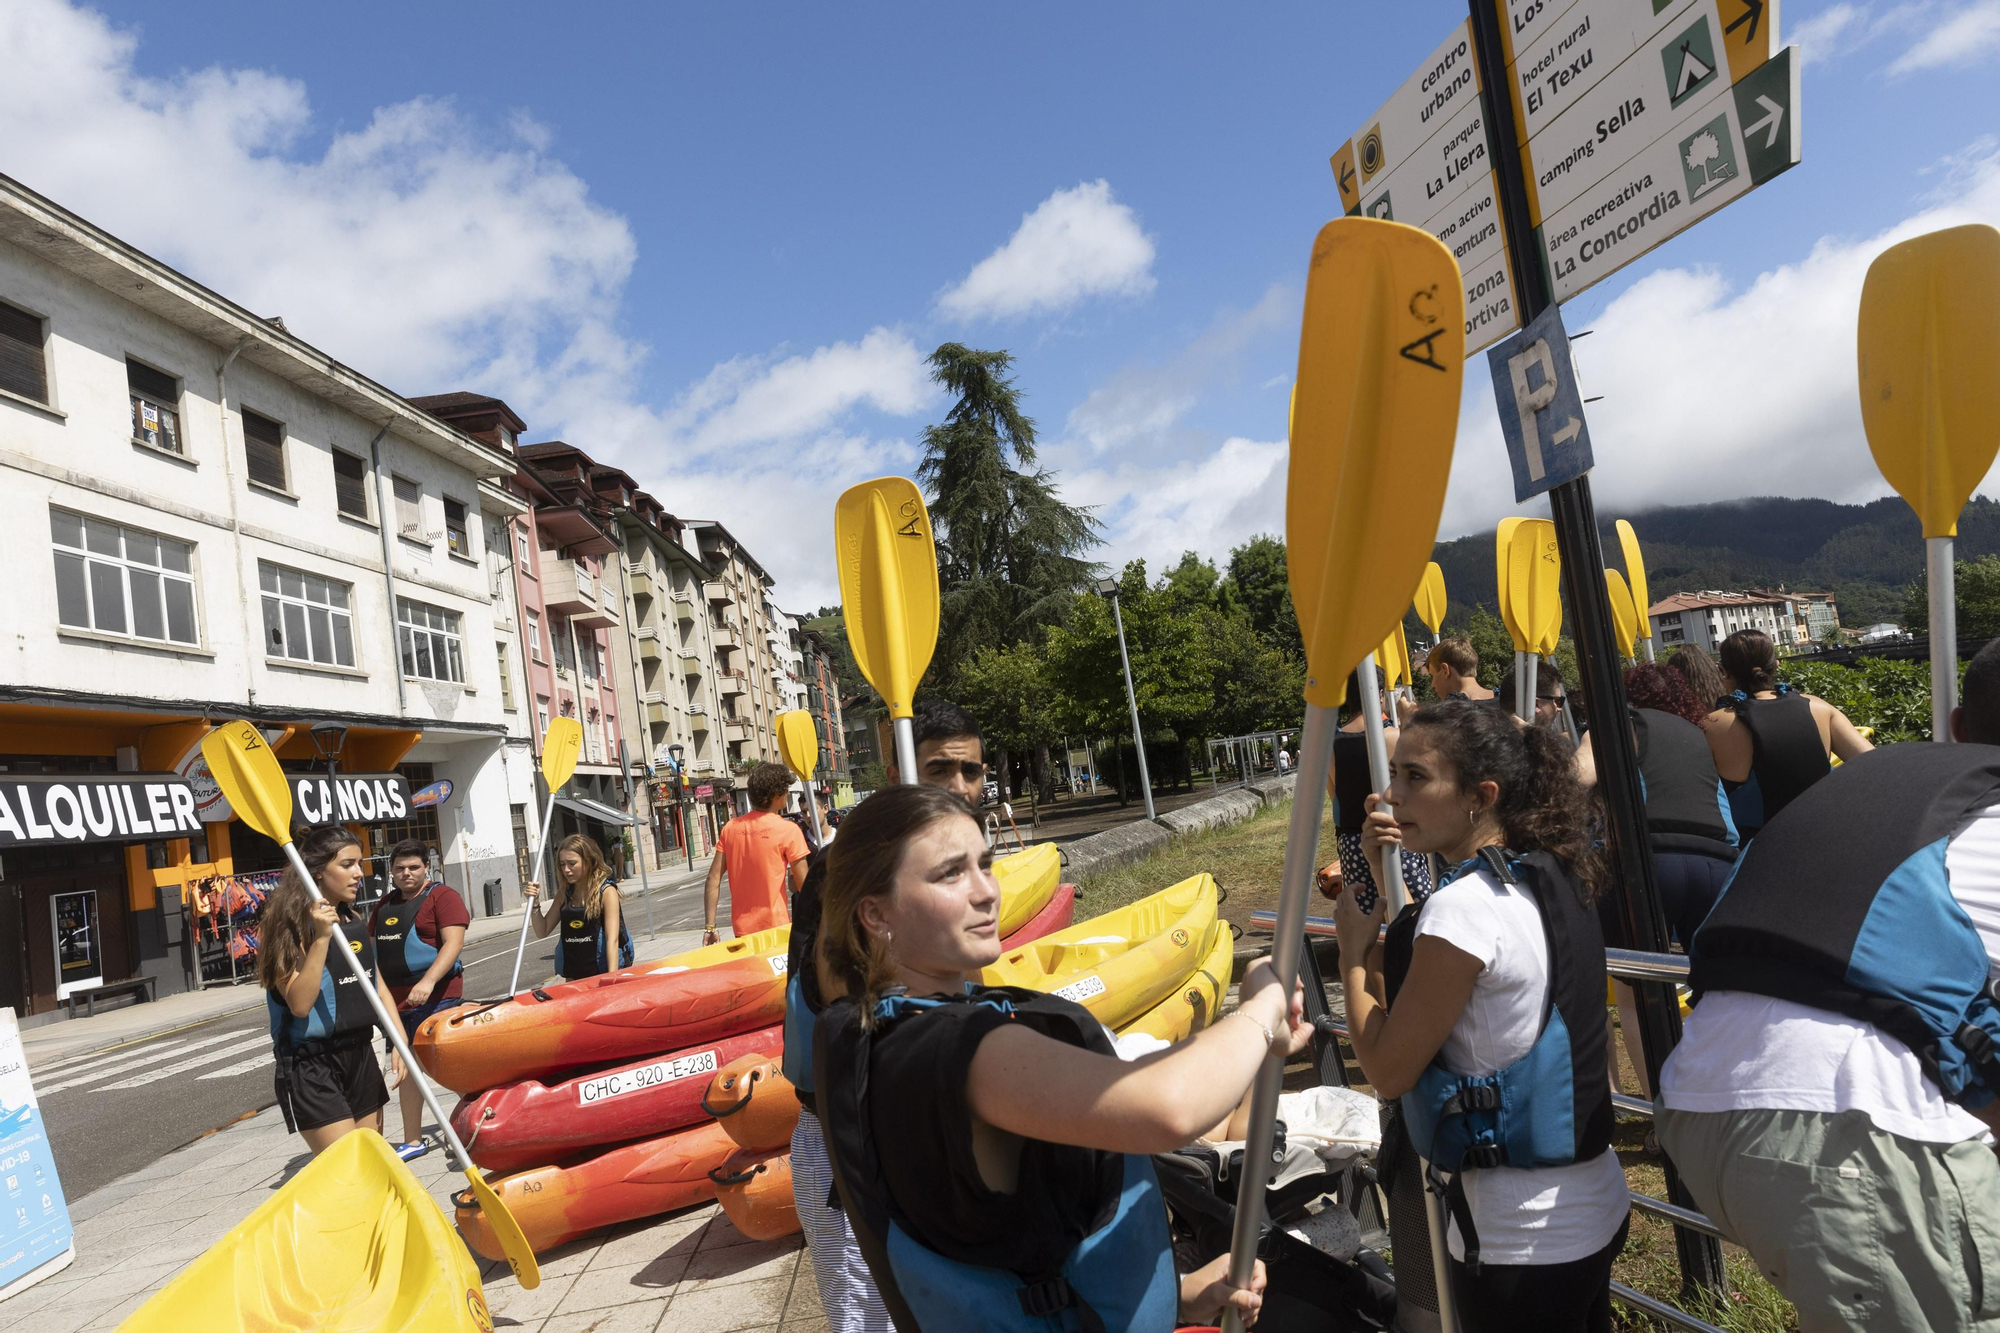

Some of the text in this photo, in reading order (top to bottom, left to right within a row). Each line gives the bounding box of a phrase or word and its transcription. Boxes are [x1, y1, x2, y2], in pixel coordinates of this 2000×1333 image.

[1513, 0, 1544, 34] Los
[1420, 40, 1467, 93] centro
[1522, 15, 1591, 88] hotel rural
[1420, 67, 1471, 124] urbano
[1526, 48, 1594, 116] El Texu
[1442, 118, 1481, 160] parque
[1540, 97, 1646, 188] camping Sella
[1426, 142, 1486, 200] La Llera
[1459, 196, 1492, 227] activo
[1549, 174, 1653, 252] área recreativa
[1554, 189, 1682, 281] La Concordia
[1467, 269, 1505, 304] zona
[1508, 336, 1558, 482] P
[0, 784, 202, 841] ALQUILER
[298, 779, 406, 823] CANOAS
[584, 1076, 621, 1101] CHC
[635, 1066, 663, 1088] 920
